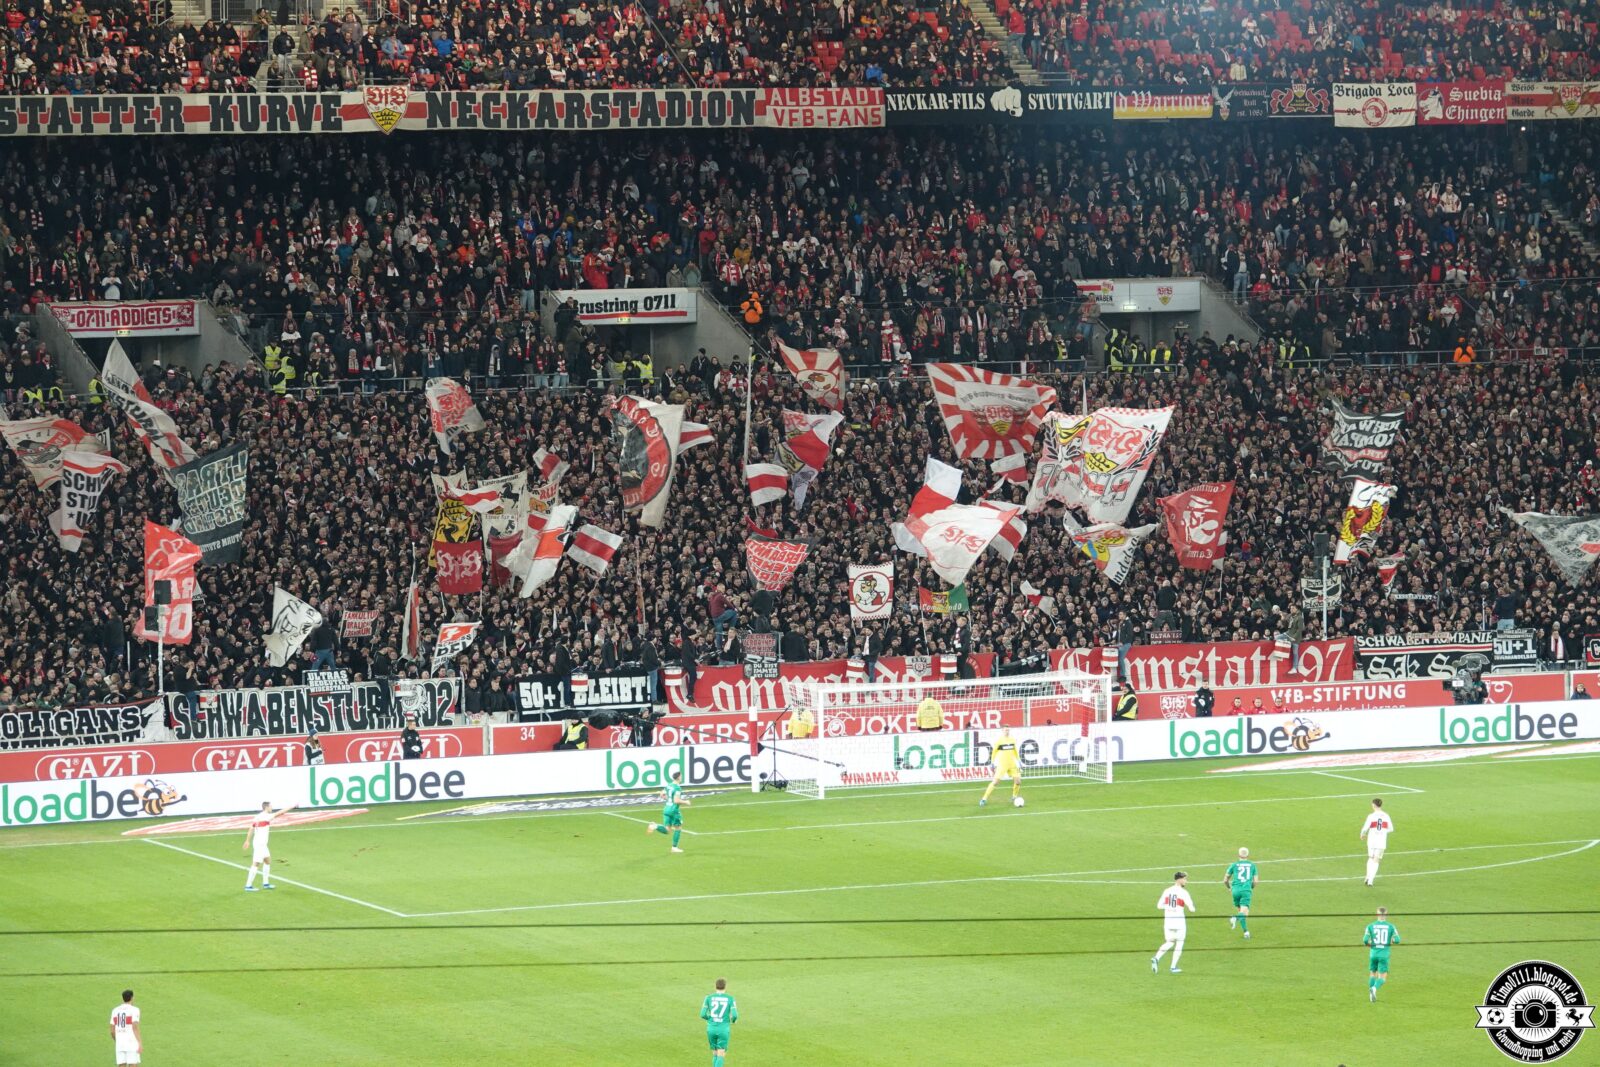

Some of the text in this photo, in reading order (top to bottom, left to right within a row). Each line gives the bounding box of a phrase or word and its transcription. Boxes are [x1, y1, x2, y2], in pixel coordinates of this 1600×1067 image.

[770, 87, 882, 106] ALBSTADT
[1028, 91, 1112, 111] STUTTGART
[1334, 84, 1414, 99] Brigada Loca
[1449, 87, 1502, 103] Suebia
[426, 90, 756, 129] NECKARSTADION
[887, 92, 984, 112] NECKAR-FILS
[210, 94, 342, 133] KURVE
[772, 106, 882, 127] VFB-FANS
[1445, 105, 1505, 122] Ehingen
[643, 293, 676, 311] 0711
[76, 306, 172, 328] 0711 ADDICTS
[1356, 632, 1430, 647] SCHWABEN
[1433, 631, 1493, 646] KOMPANIE
[1494, 639, 1537, 655] 50+1
[1298, 643, 1347, 684] 97
[307, 670, 348, 681] ULTRAS
[519, 680, 565, 709] 50+1
[1271, 683, 1406, 704] VfB-STIFTUNG
[1055, 699, 1070, 713] 35
[855, 708, 1002, 737] JOKESTAR
[1440, 704, 1578, 745] loadbee
[520, 726, 536, 741] 34
[894, 731, 1123, 771] loadbe.com
[606, 746, 751, 789] loadbee
[310, 761, 466, 806] loadbee
[1237, 866, 1251, 883] 21
[1168, 893, 1178, 909] 16
[1373, 928, 1389, 945] 30
[710, 1001, 728, 1018] 27
[117, 1012, 126, 1028] 18
